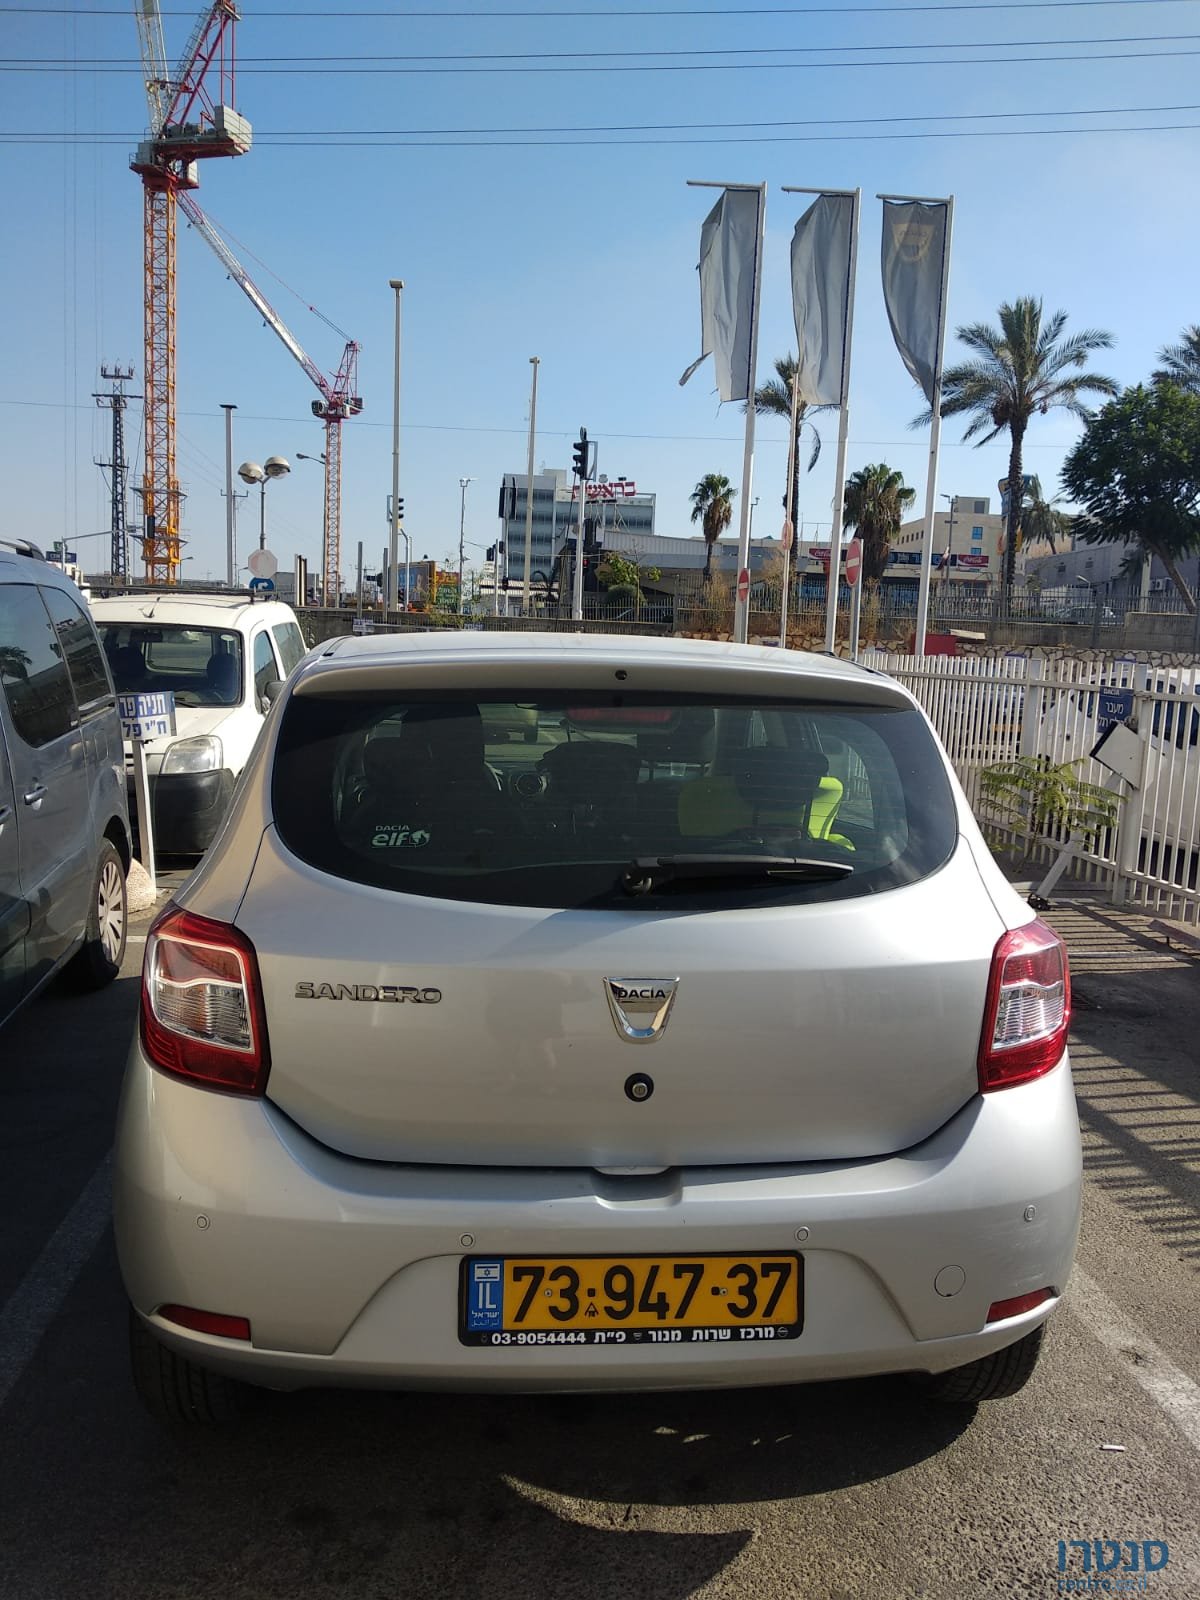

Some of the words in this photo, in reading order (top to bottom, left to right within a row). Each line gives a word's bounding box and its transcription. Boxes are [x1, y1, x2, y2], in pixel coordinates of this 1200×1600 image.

[138, 694, 166, 716] חניה
[1105, 702, 1124, 714] מעבר
[375, 824, 410, 832] DACIA
[371, 831, 410, 846] elf
[295, 981, 442, 1004] SANDERO
[616, 987, 666, 999] DACIA
[478, 1282, 497, 1309] IL
[471, 1310, 500, 1318] ישראל
[491, 1331, 587, 1345] 03-9054444
[648, 1329, 682, 1342] מנור
[691, 1328, 731, 1341] שרות
[739, 1326, 775, 1339] מרכז
